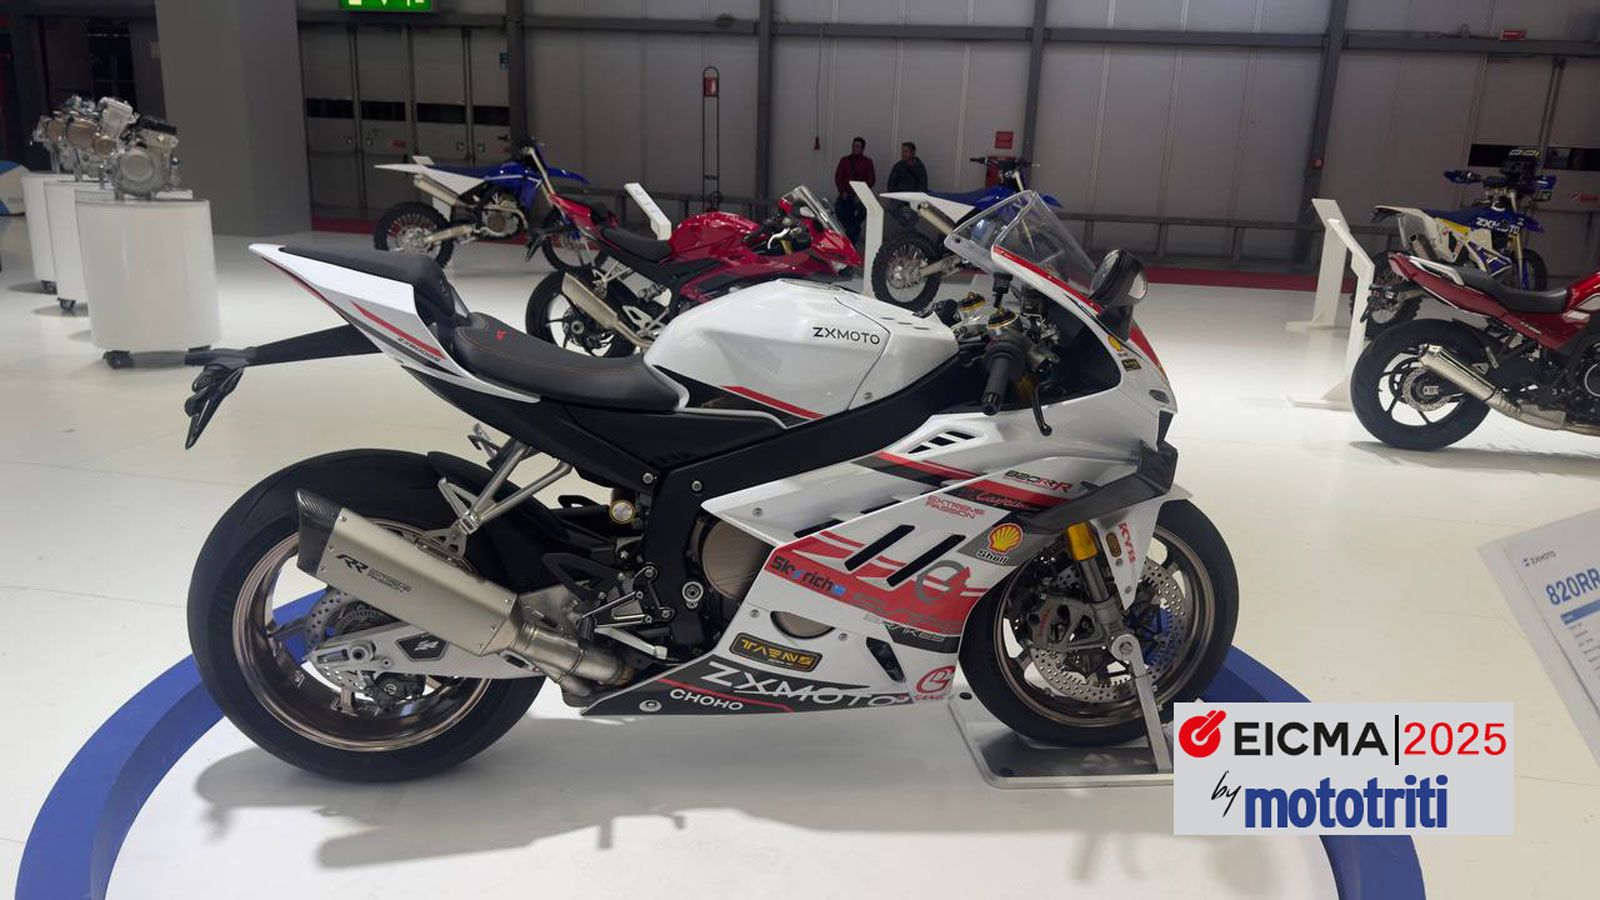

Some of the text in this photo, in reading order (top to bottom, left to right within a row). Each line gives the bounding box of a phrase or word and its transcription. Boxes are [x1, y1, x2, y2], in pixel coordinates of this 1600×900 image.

[812, 326, 881, 345] ZXMOTO
[975, 549, 1009, 565] Shell
[701, 660, 898, 706] ZXMOTO
[669, 688, 744, 711] CHOHO
